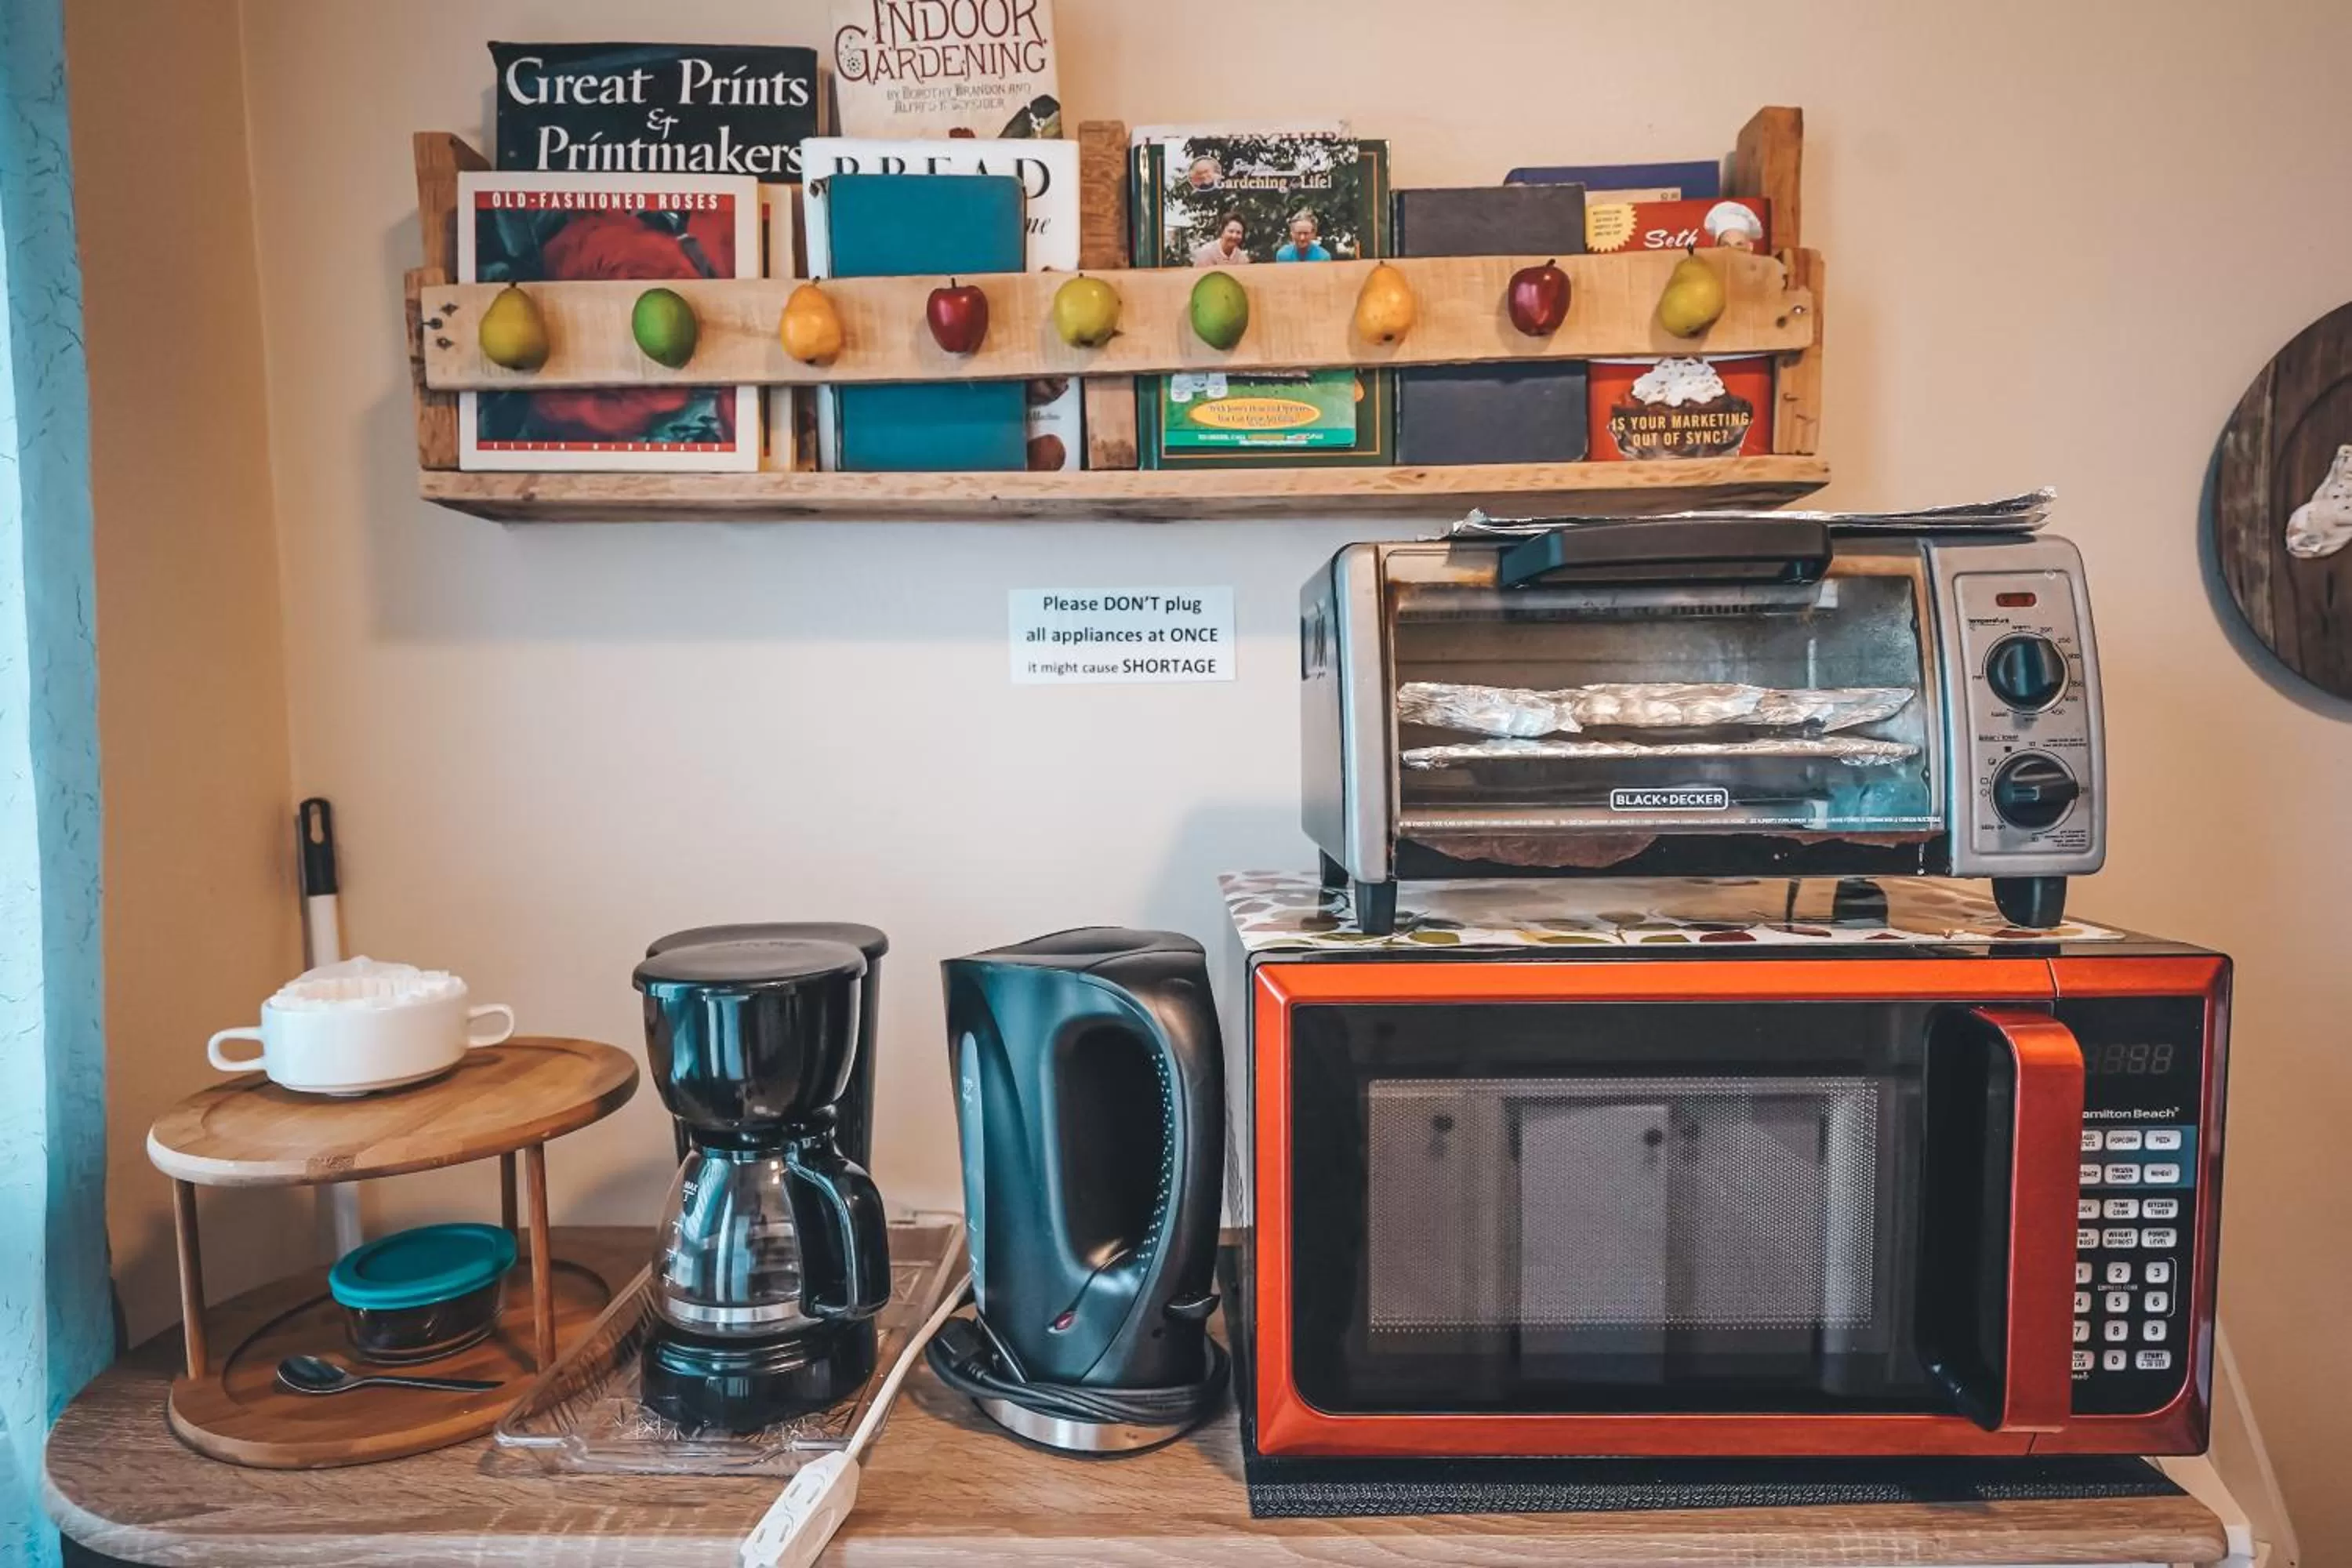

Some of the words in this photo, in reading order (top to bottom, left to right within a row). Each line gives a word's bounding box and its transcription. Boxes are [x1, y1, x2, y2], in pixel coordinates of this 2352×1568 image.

[873, 0, 1046, 49] INDOOR
[835, 25, 1047, 84] GARDENING
[506, 57, 654, 106] Great
[677, 58, 809, 107] Prints
[646, 107, 679, 140] &
[536, 125, 803, 173] Printmakers
[1213, 175, 1288, 194] Gardening
[492, 191, 646, 209] OLD-FASHIONED
[658, 193, 719, 209] ROSES
[1643, 228, 1699, 249] Seth
[1613, 417, 1625, 431] IS
[1630, 416, 1666, 430] YOUR
[1671, 412, 1751, 428] MARKETING
[1632, 432, 1657, 447] OUT
[1664, 431, 1680, 445] OF
[1686, 429, 1729, 445] SYNC?
[1043, 596, 1098, 611] Please
[1104, 596, 1160, 611] DON’T
[1166, 596, 1203, 615] plug
[1026, 627, 1046, 642] all
[1051, 627, 1142, 644] appliances
[1148, 628, 1165, 642] at
[1171, 628, 1218, 642] ONCE
[1028, 662, 1036, 673] it
[1040, 662, 1078, 675] might
[1082, 663, 1119, 673] cause
[1123, 659, 1217, 673] SHORTAGE
[1616, 794, 1723, 806] BLACK+DECKER
[2082, 1109, 2131, 1119] amilton
[2078, 1269, 2083, 1278] 1
[2115, 1268, 2122, 1278] 2
[2154, 1268, 2161, 1277] 3
[2075, 1298, 2082, 1307] 4
[2114, 1297, 2121, 1307] 5
[2152, 1297, 2160, 1306] 6
[2075, 1326, 2082, 1336] 7
[2113, 1326, 2120, 1336] 8
[2151, 1326, 2158, 1335] 9
[2111, 1356, 2118, 1365] 0
